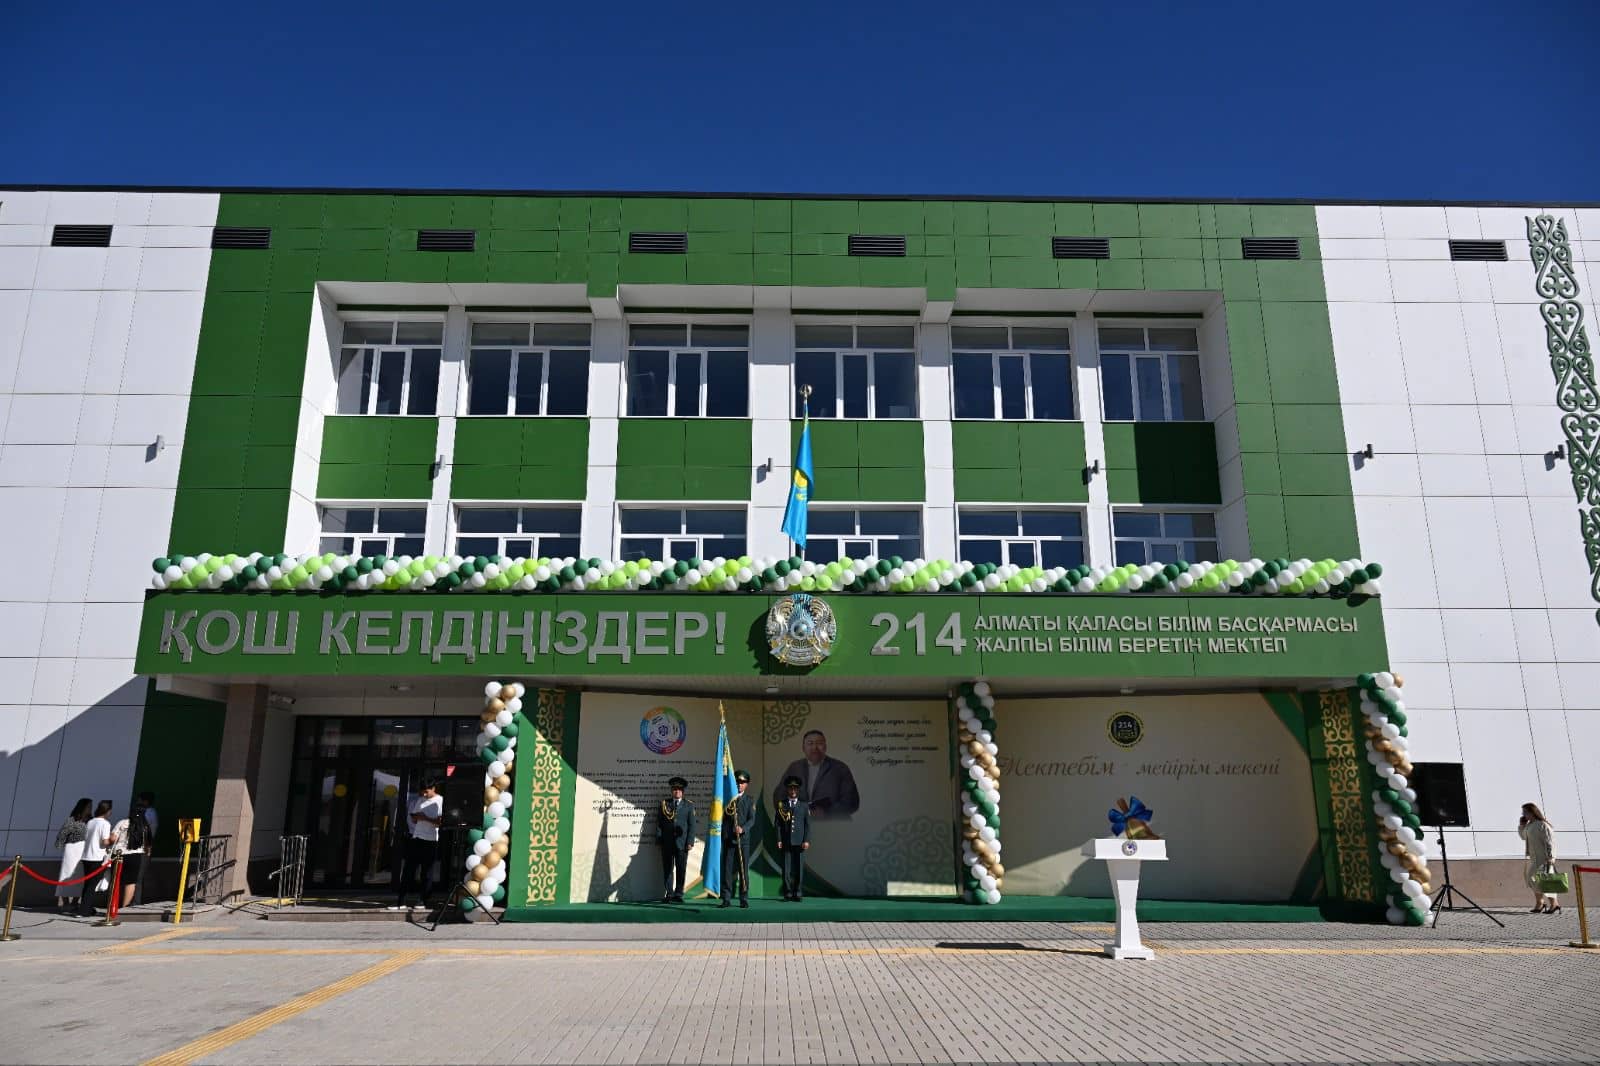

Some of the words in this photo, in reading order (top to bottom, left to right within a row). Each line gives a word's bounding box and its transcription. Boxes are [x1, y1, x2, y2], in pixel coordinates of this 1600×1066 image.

[870, 612, 967, 655] 214
[974, 615, 1060, 631] АЛМАТЫ
[1067, 615, 1151, 634] ҚАЛАСЫ
[1158, 616, 1212, 632] БІЛІМ
[1218, 616, 1358, 635] БАСҚАРМАСЫ
[158, 610, 299, 663] ҚОШ
[319, 610, 726, 664] КЕЛДІҢІЗДЕР!
[974, 636, 1052, 652] ЖАЛПЫ
[1060, 636, 1112, 652] БІЛІМ
[1119, 637, 1201, 653] БЕРЕТІН
[1208, 638, 1288, 653] МЕКТЕП
[1215, 758, 1280, 776] мекені
